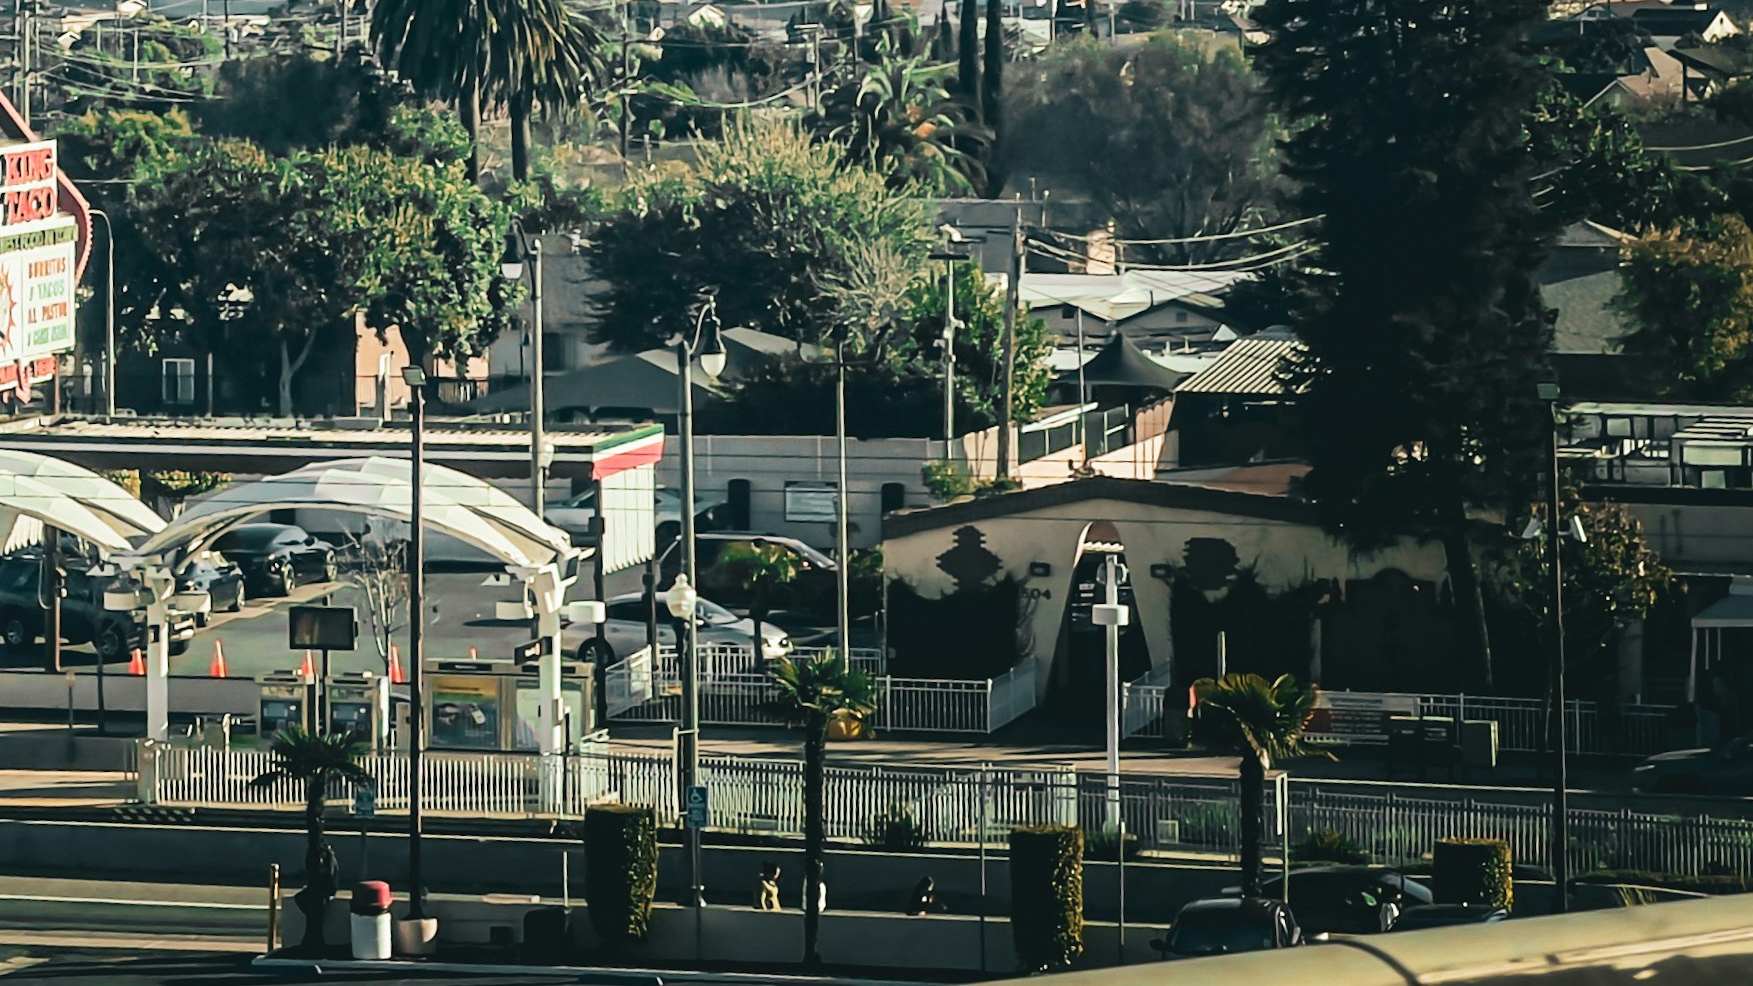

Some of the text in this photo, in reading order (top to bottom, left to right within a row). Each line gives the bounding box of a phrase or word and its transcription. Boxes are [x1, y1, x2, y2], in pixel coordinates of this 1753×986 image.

[2, 148, 54, 186] KING
[3, 186, 56, 225] TACO
[28, 257, 66, 279] BURRITOS
[38, 278, 65, 299] TACOS
